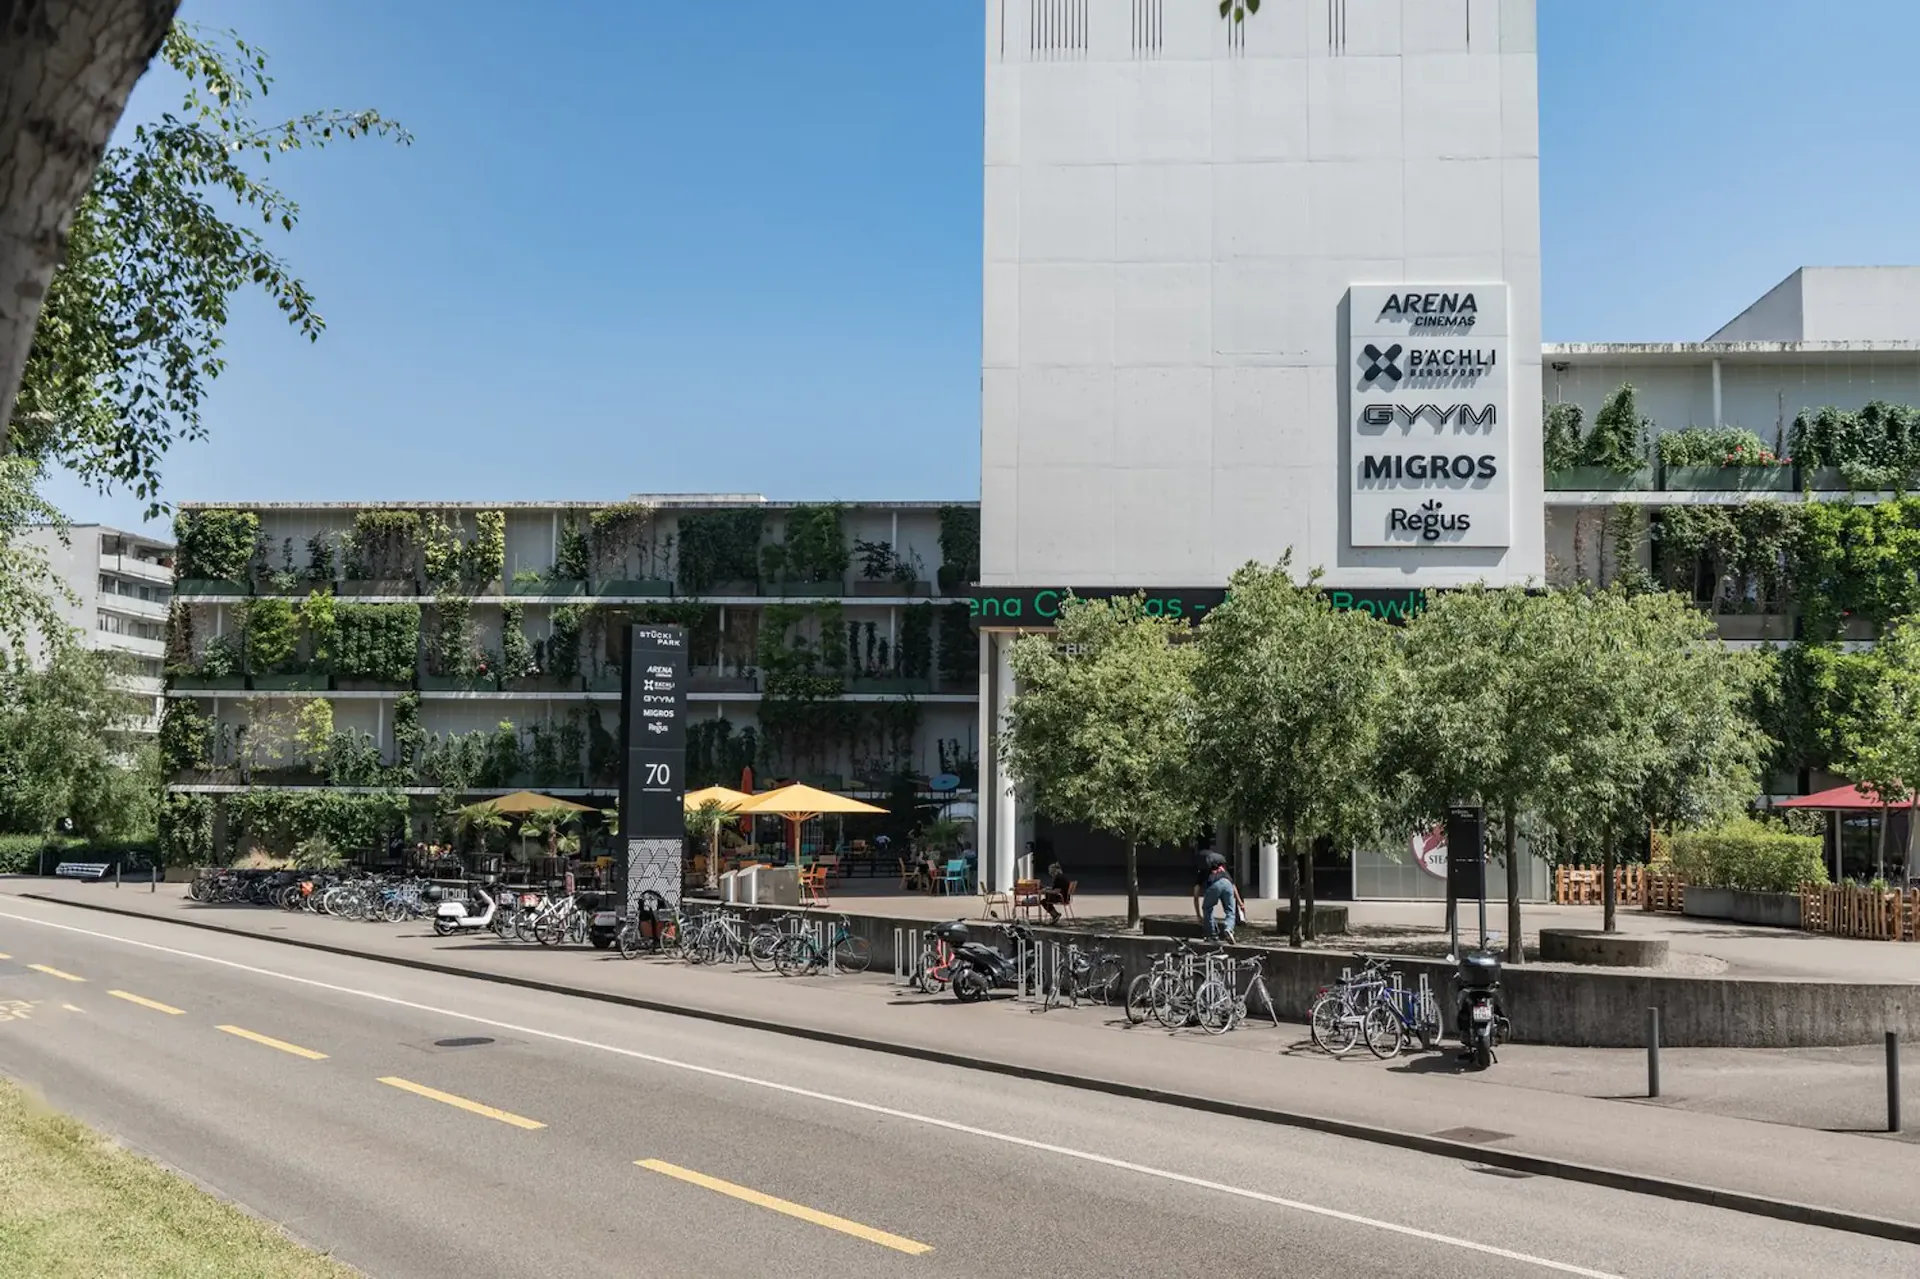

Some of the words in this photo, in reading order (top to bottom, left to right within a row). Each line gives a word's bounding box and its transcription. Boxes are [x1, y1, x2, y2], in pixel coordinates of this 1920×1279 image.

[1381, 293, 1478, 313] ARENA
[1415, 316, 1476, 327] CINEMAS
[1410, 349, 1496, 366] BÄCHLI
[1410, 368, 1483, 377] BERGSPORT
[1364, 404, 1497, 425] GYYM
[1364, 454, 1497, 479] MIGROS
[1391, 501, 1471, 540] Regus
[1332, 591, 1424, 619] Bowli
[640, 630, 672, 639] STÜCKI
[646, 666, 672, 674] ARENA
[643, 709, 674, 717] MIGROS
[644, 763, 671, 785] 70
[1428, 855, 1448, 865] STE
